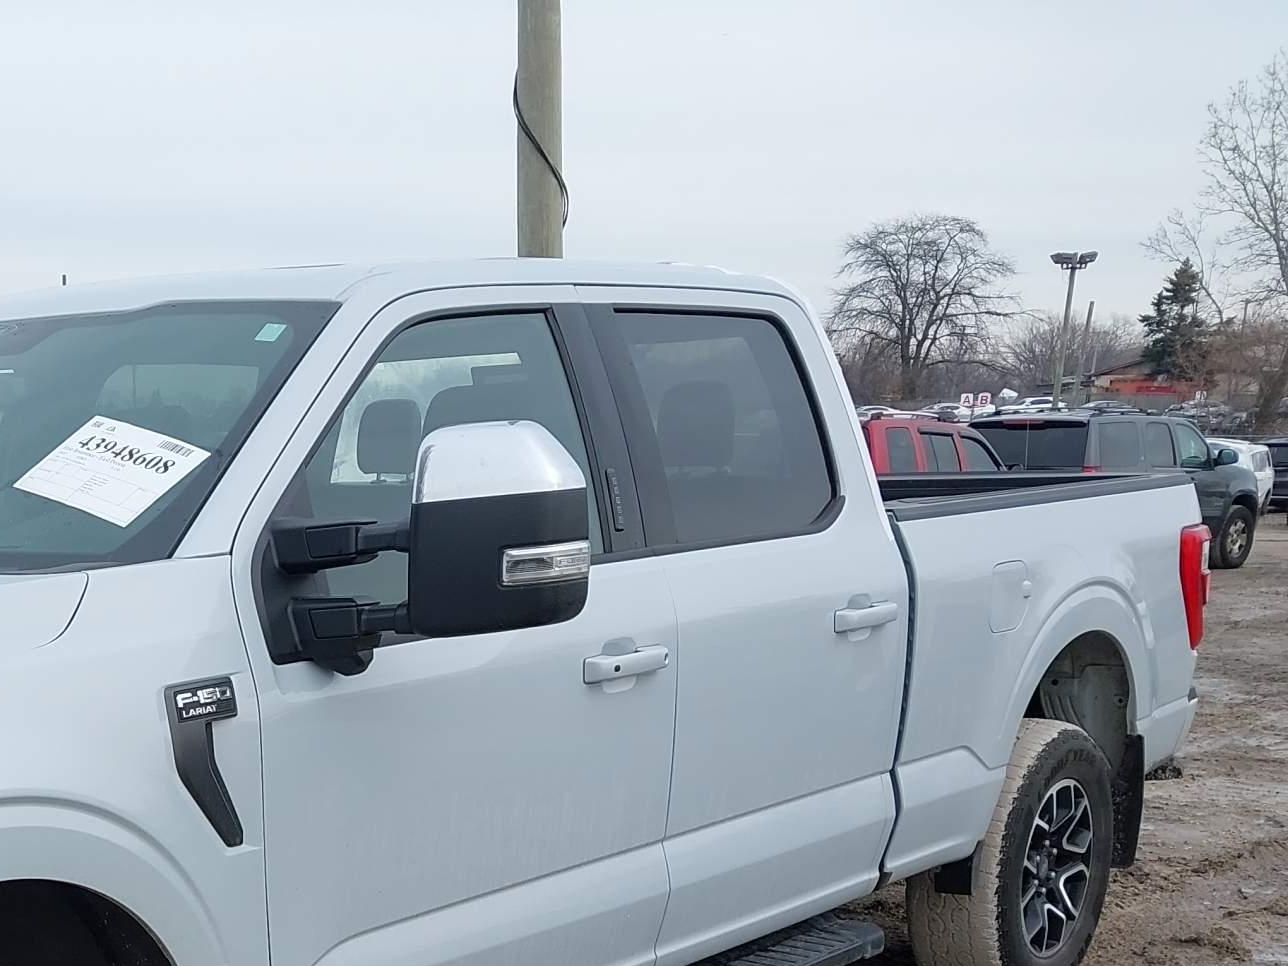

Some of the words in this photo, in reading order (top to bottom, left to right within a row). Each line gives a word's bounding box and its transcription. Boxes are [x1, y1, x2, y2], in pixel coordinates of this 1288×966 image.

[963, 395, 971, 405] A
[979, 395, 989, 405] B
[78, 436, 176, 475] 43948608
[177, 688, 232, 708] F-150
[182, 704, 218, 719] LARIAT
